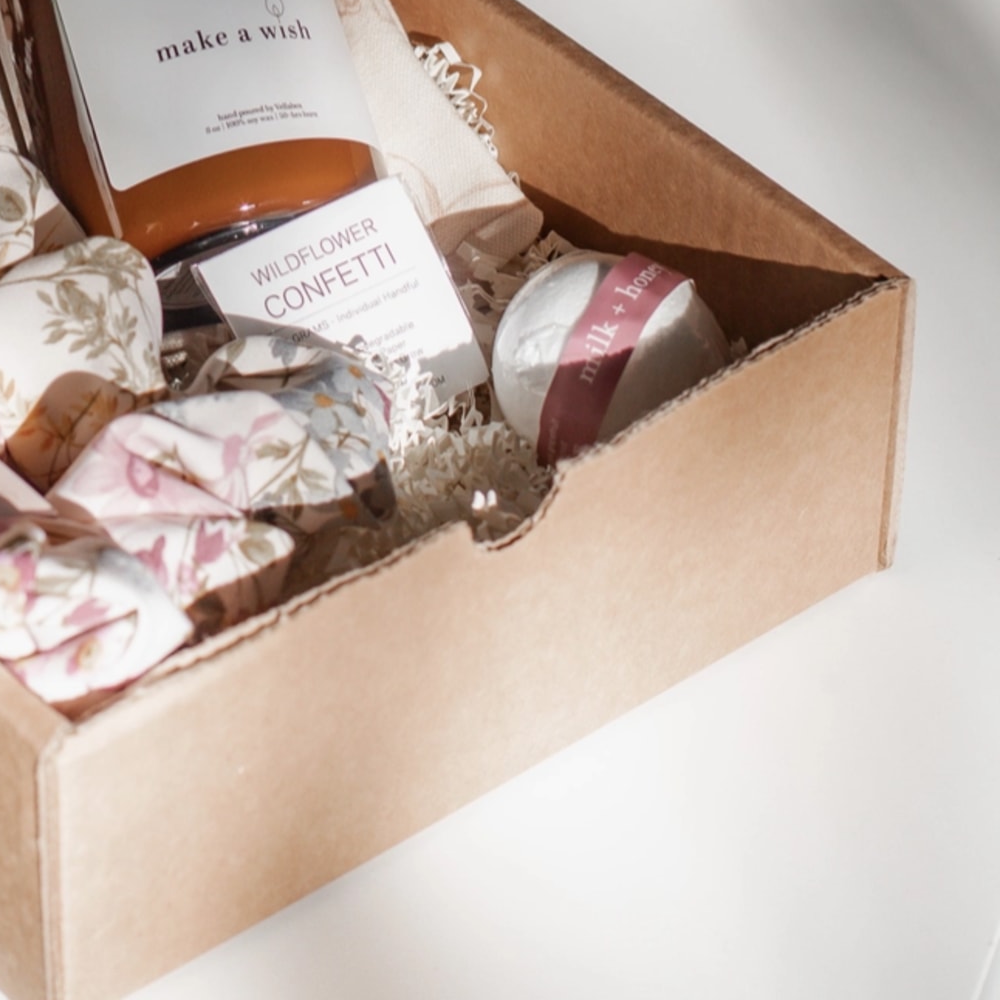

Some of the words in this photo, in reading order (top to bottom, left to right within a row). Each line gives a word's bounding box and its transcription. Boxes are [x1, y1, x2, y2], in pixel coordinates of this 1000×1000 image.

[156, 29, 230, 64] make
[237, 26, 253, 44] a
[259, 18, 312, 41] wish
[250, 217, 379, 287] WILDFLOWER
[263, 242, 397, 319] CONFETTI
[336, 297, 382, 323] Individual
[382, 279, 420, 302] Handful
[579, 321, 620, 385] milk
[611, 302, 627, 317] +
